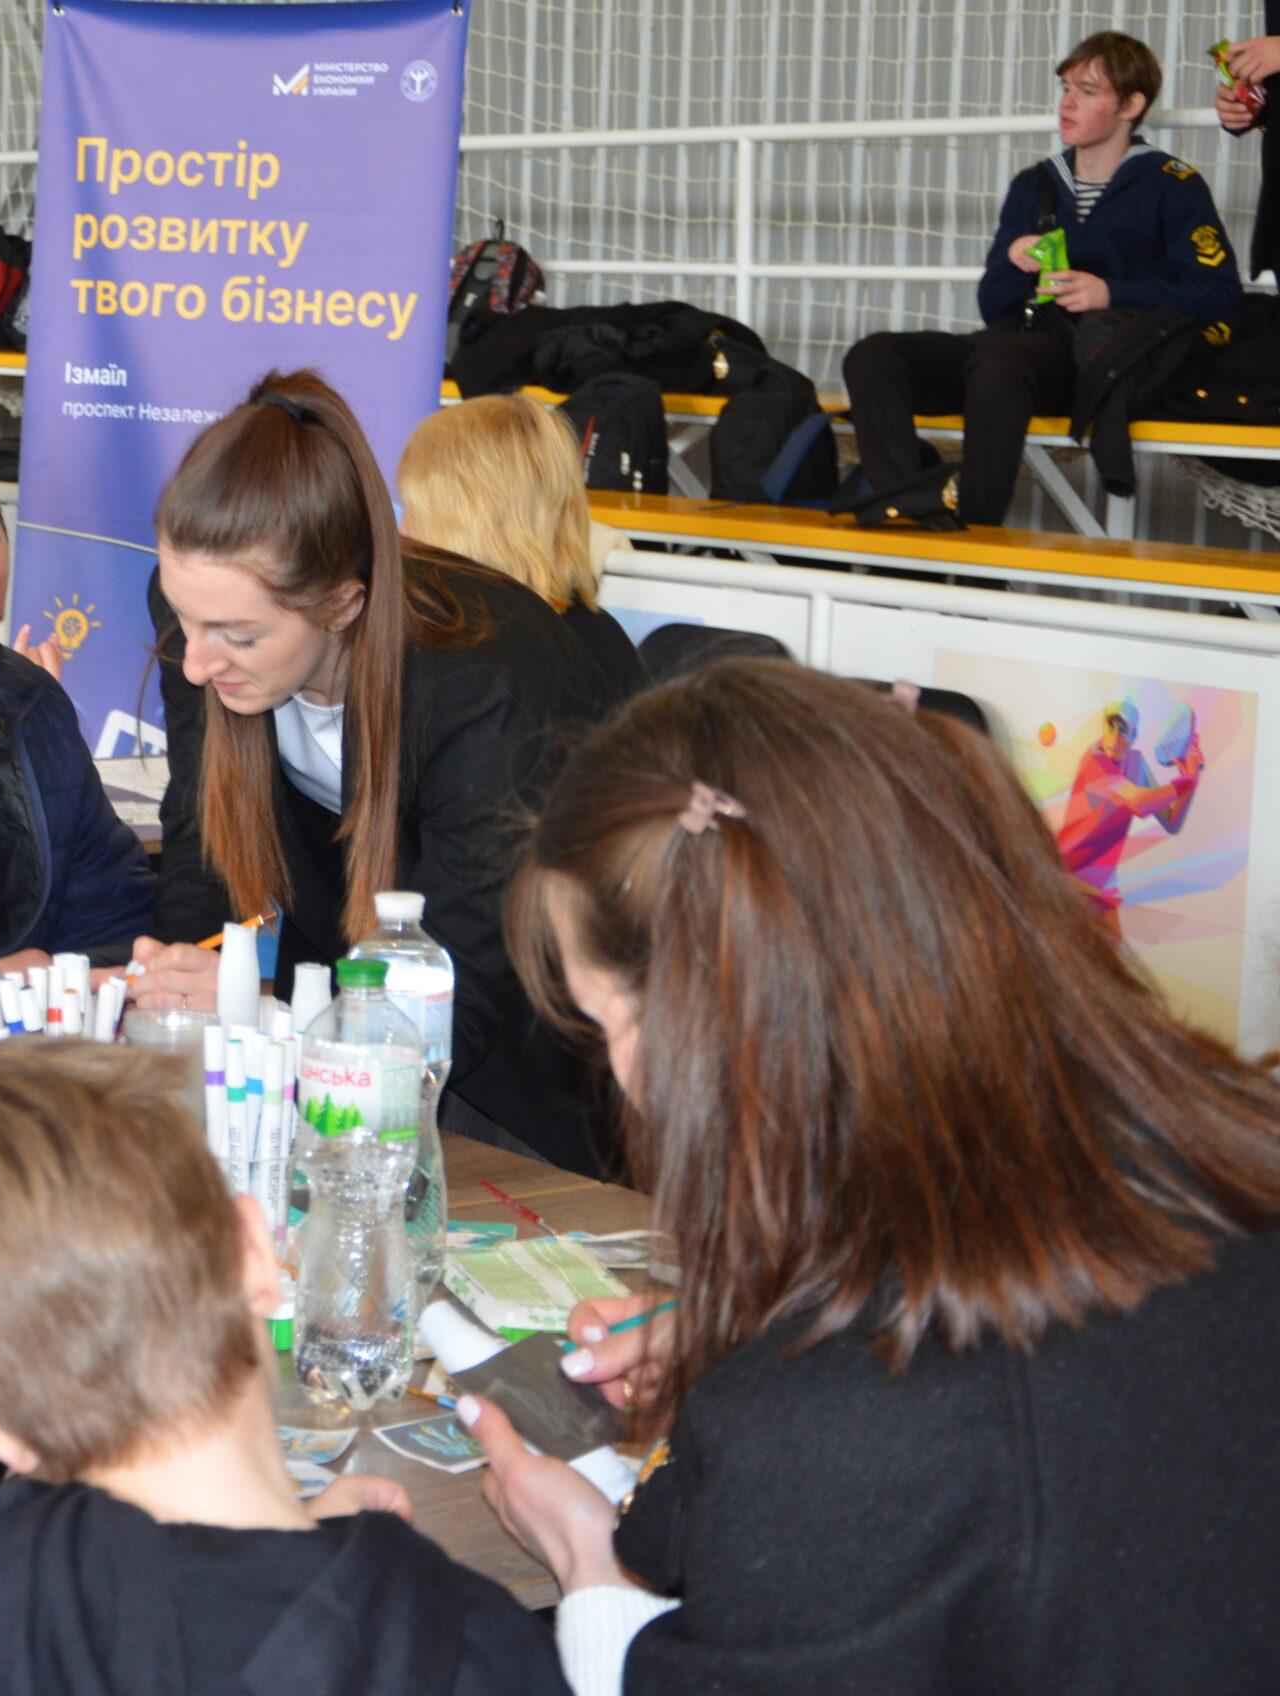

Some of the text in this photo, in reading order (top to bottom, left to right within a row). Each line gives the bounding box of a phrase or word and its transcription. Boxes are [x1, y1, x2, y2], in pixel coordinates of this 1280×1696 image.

[75, 136, 281, 200] Простір
[72, 212, 310, 270] розвитку
[69, 274, 419, 342] твого бізнесу
[64, 361, 128, 387] Ізмаїл
[62, 401, 223, 424] проспект Незалеж
